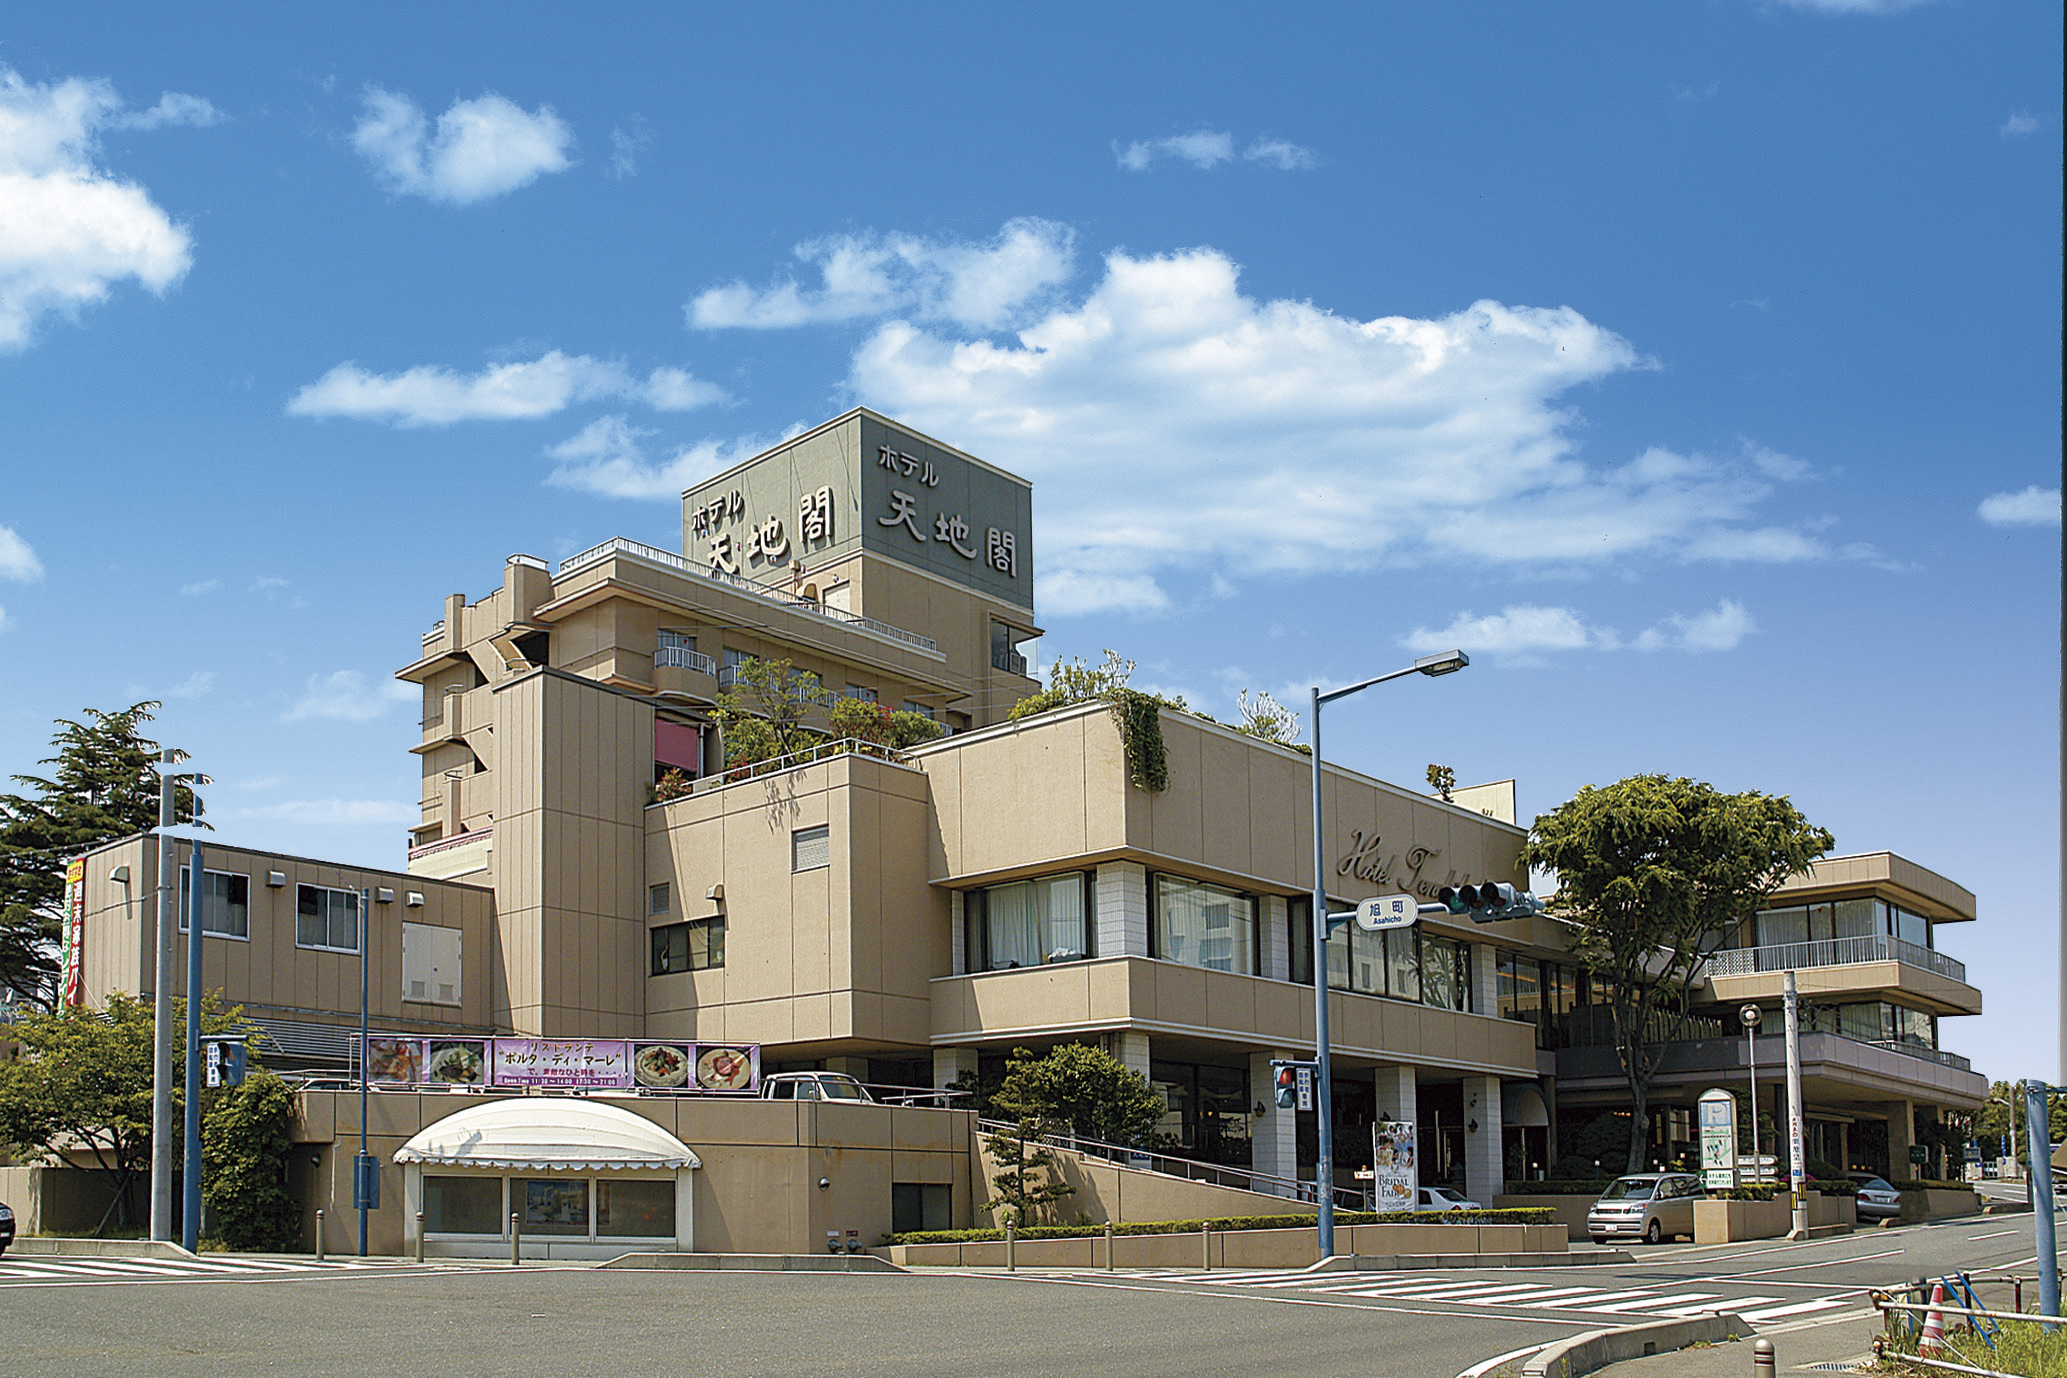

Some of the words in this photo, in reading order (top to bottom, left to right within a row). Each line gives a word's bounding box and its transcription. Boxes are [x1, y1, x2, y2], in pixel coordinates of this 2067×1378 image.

[877, 444, 939, 488] ホテル
[691, 489, 744, 531] ホテル
[706, 485, 834, 574] 天地閣
[877, 490, 1017, 578] 天地閣
[1336, 828, 1395, 885] Hotel
[1369, 900, 1404, 917] 旭町
[1373, 915, 1402, 925] Asahicho
[531, 1041, 594, 1053] リストランテ
[1706, 1103, 1727, 1125] P
